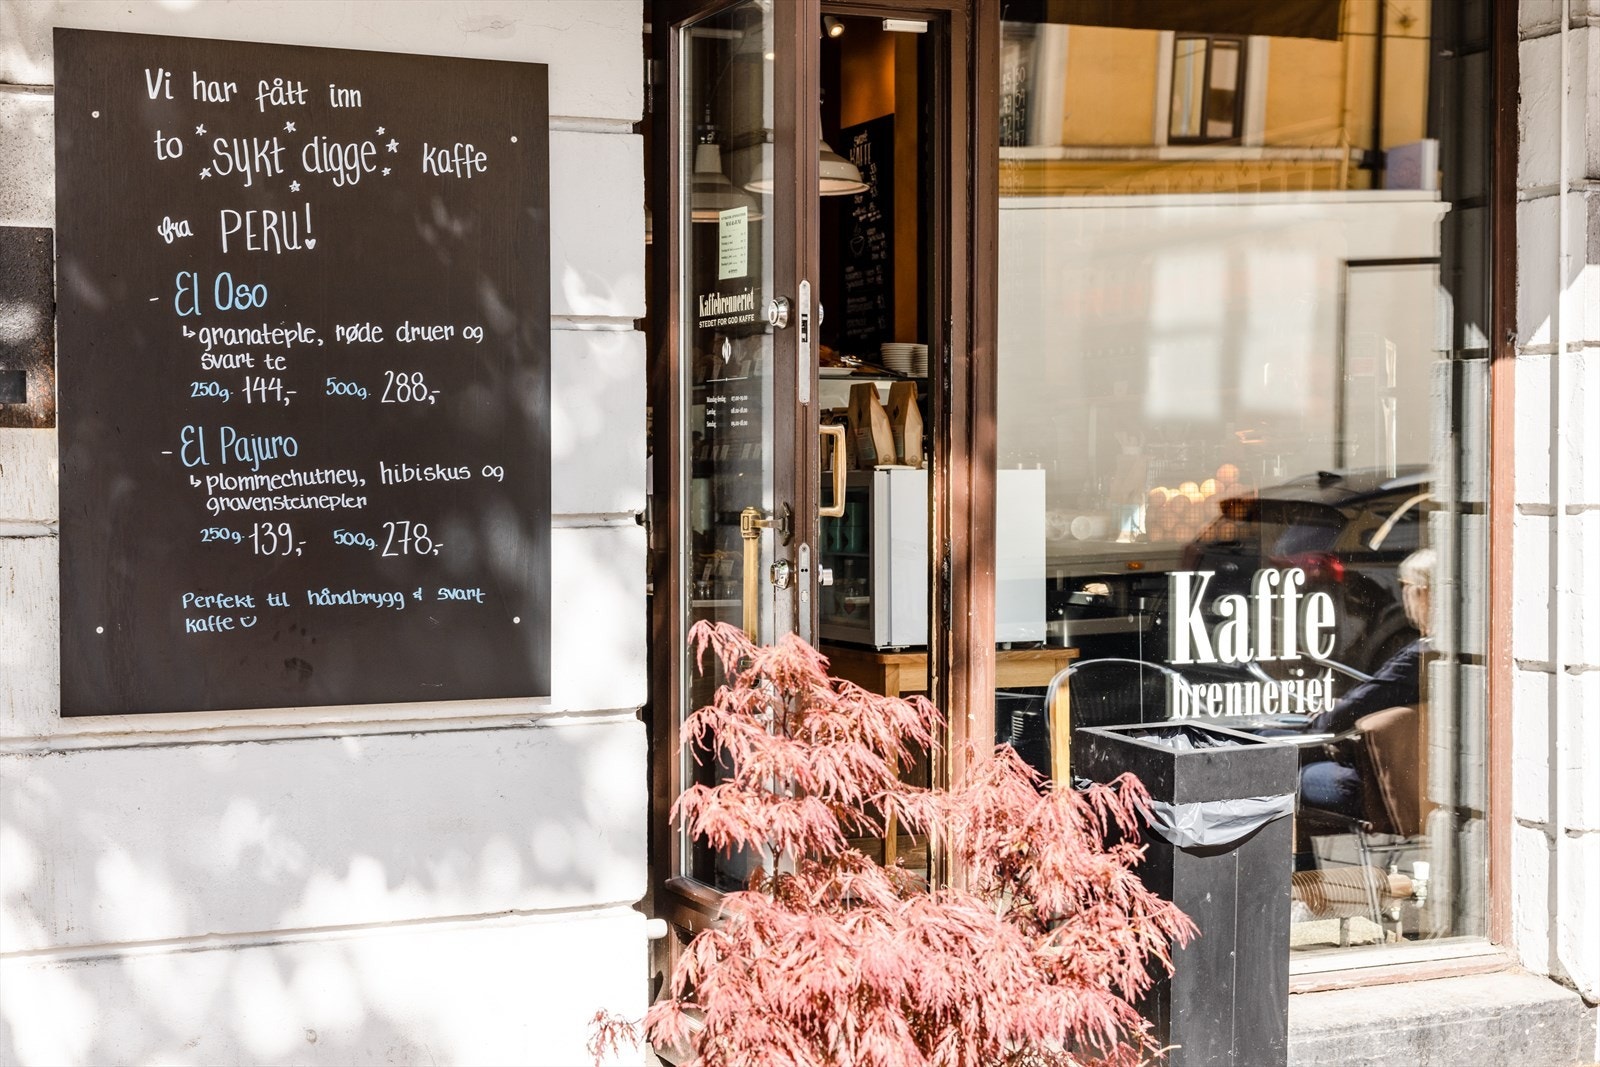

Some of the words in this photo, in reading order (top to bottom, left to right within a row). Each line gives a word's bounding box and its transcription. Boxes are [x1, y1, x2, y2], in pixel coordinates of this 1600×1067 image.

[145, 68, 174, 100] Vi
[192, 71, 237, 103] har
[255, 78, 309, 112] fått
[329, 83, 362, 108] inn
[154, 129, 183, 161] to
[302, 136, 377, 187] digge
[422, 142, 488, 179] kaffe
[157, 215, 194, 244] fra
[220, 203, 316, 254] PERU!
[174, 270, 201, 317] El
[214, 270, 268, 310] Oso
[699, 286, 754, 318] Kaffebrenneriet
[199, 321, 324, 351] granateple,
[335, 323, 384, 345] røde
[395, 320, 455, 343] druer
[462, 324, 484, 344] og
[699, 318, 717, 329] STEDET
[717, 317, 728, 326] FOR
[728, 315, 739, 325] GOD
[739, 313, 755, 323] KAFFE
[200, 351, 255, 371] svart
[264, 352, 287, 371] te
[241, 375, 298, 407] 144,-
[381, 370, 441, 405] 288,-
[180, 424, 207, 468] El
[220, 426, 299, 472] Pajuro
[206, 467, 366, 495] plommechutney,
[379, 461, 472, 485] hibiskus
[481, 465, 505, 483] og
[206, 493, 368, 517] gravensteinepler
[248, 522, 307, 557] 139,-
[381, 520, 444, 557] 278,-
[182, 591, 256, 610] Perfekt
[266, 591, 291, 608] til
[307, 587, 405, 611] håndbrygg
[436, 587, 486, 604] svart
[1169, 567, 1336, 664] Kaffe
[185, 614, 235, 634] kaffe
[1169, 668, 1336, 720] brenneriet
